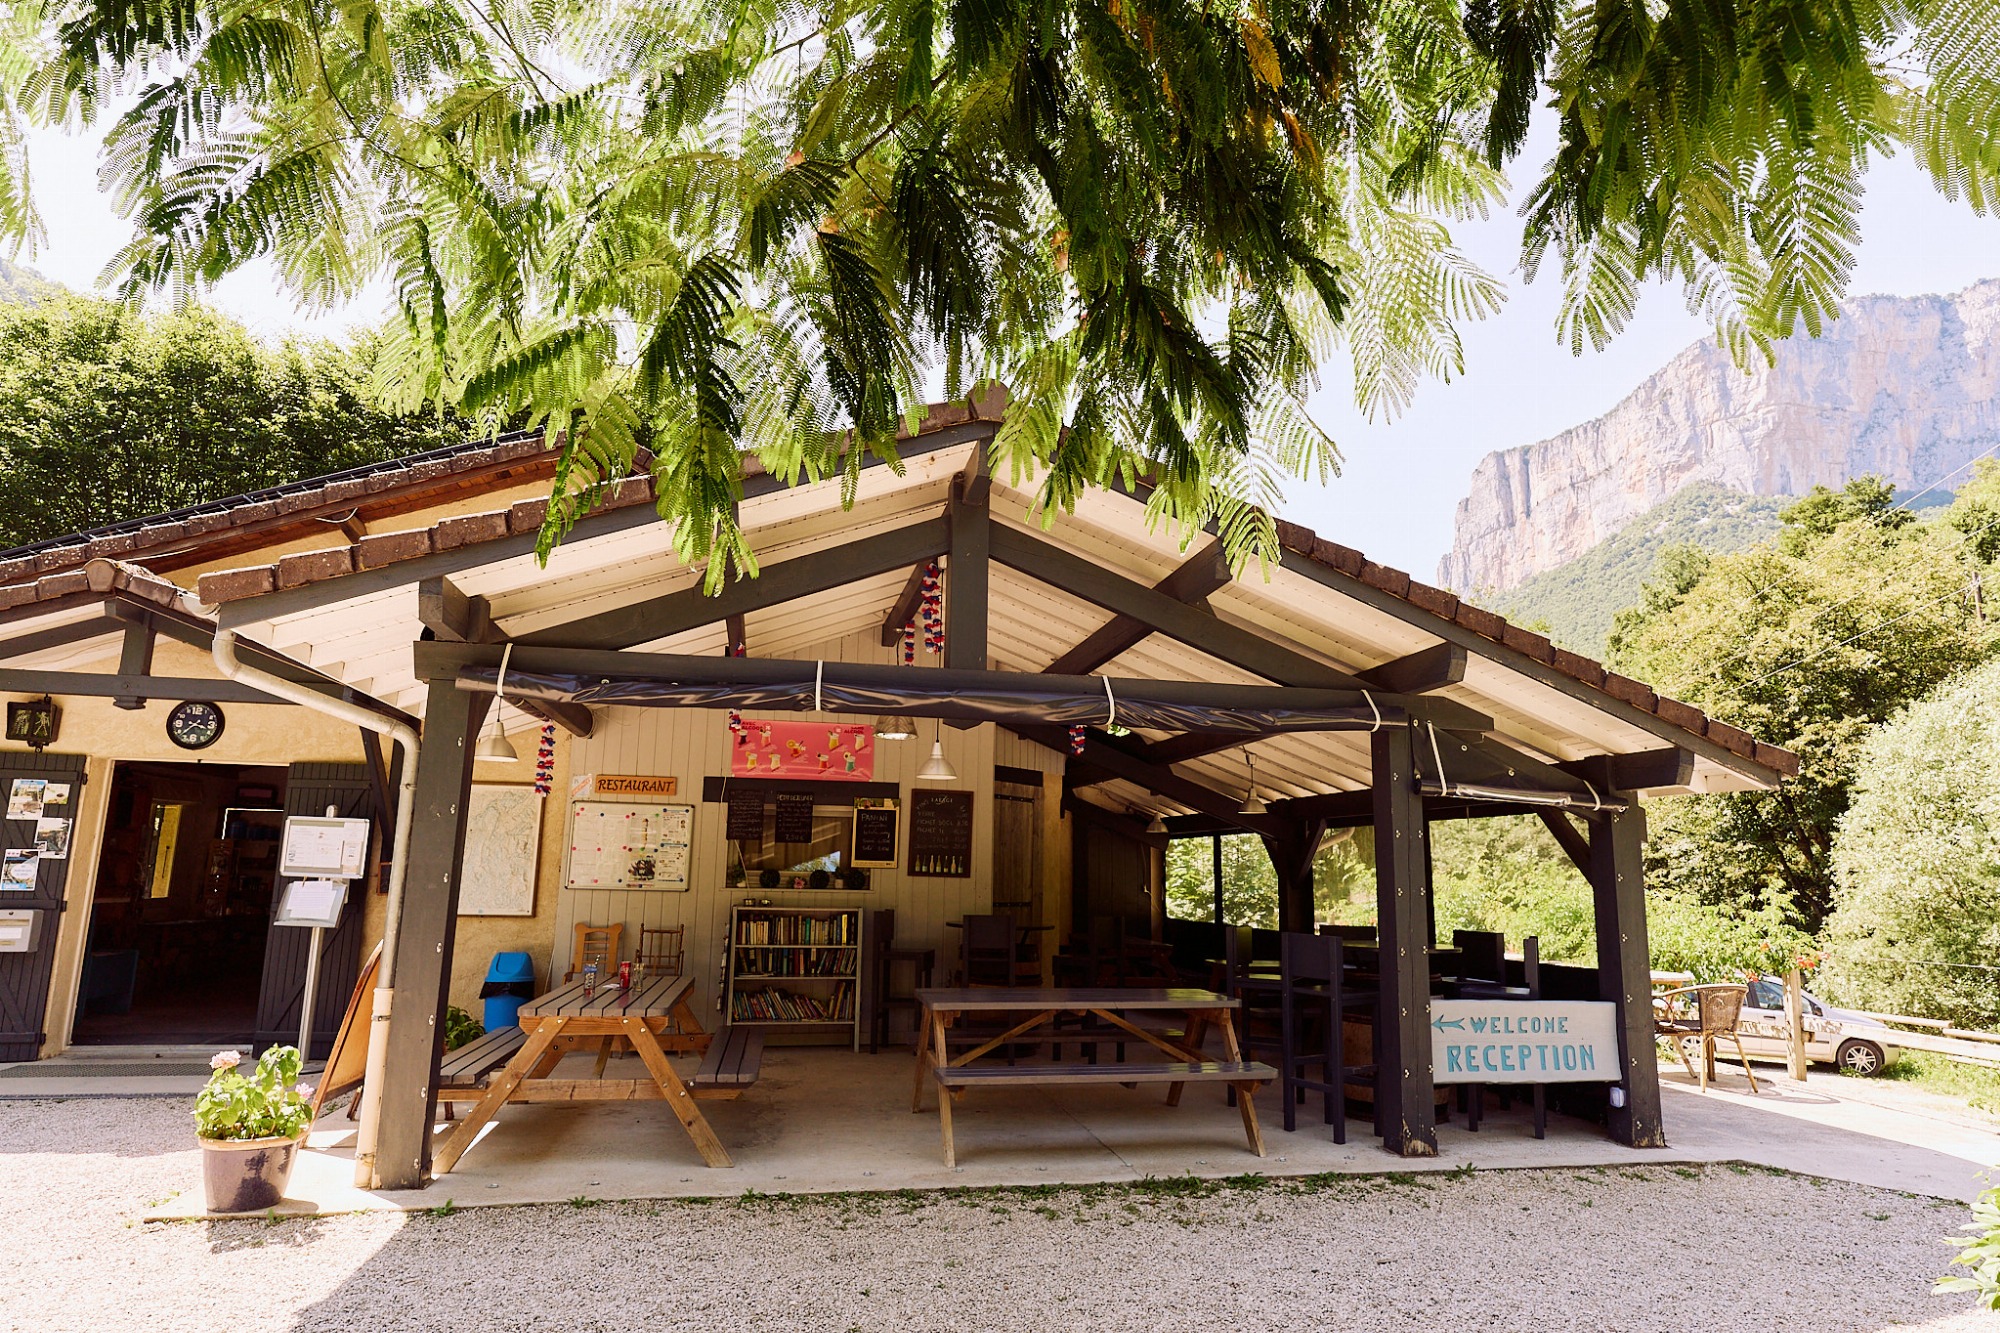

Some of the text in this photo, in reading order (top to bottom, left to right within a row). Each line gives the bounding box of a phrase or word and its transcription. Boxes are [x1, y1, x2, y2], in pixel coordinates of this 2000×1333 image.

[192, 706, 203, 715] 12
[175, 719, 183, 727] 9
[207, 721, 215, 729] 3
[189, 734, 197, 742] 6
[597, 778, 674, 792] RESTAURANT
[861, 812, 888, 822] PANINI
[1469, 1016, 1568, 1034] WELCOME
[1446, 1044, 1595, 1072] RECEPTION
